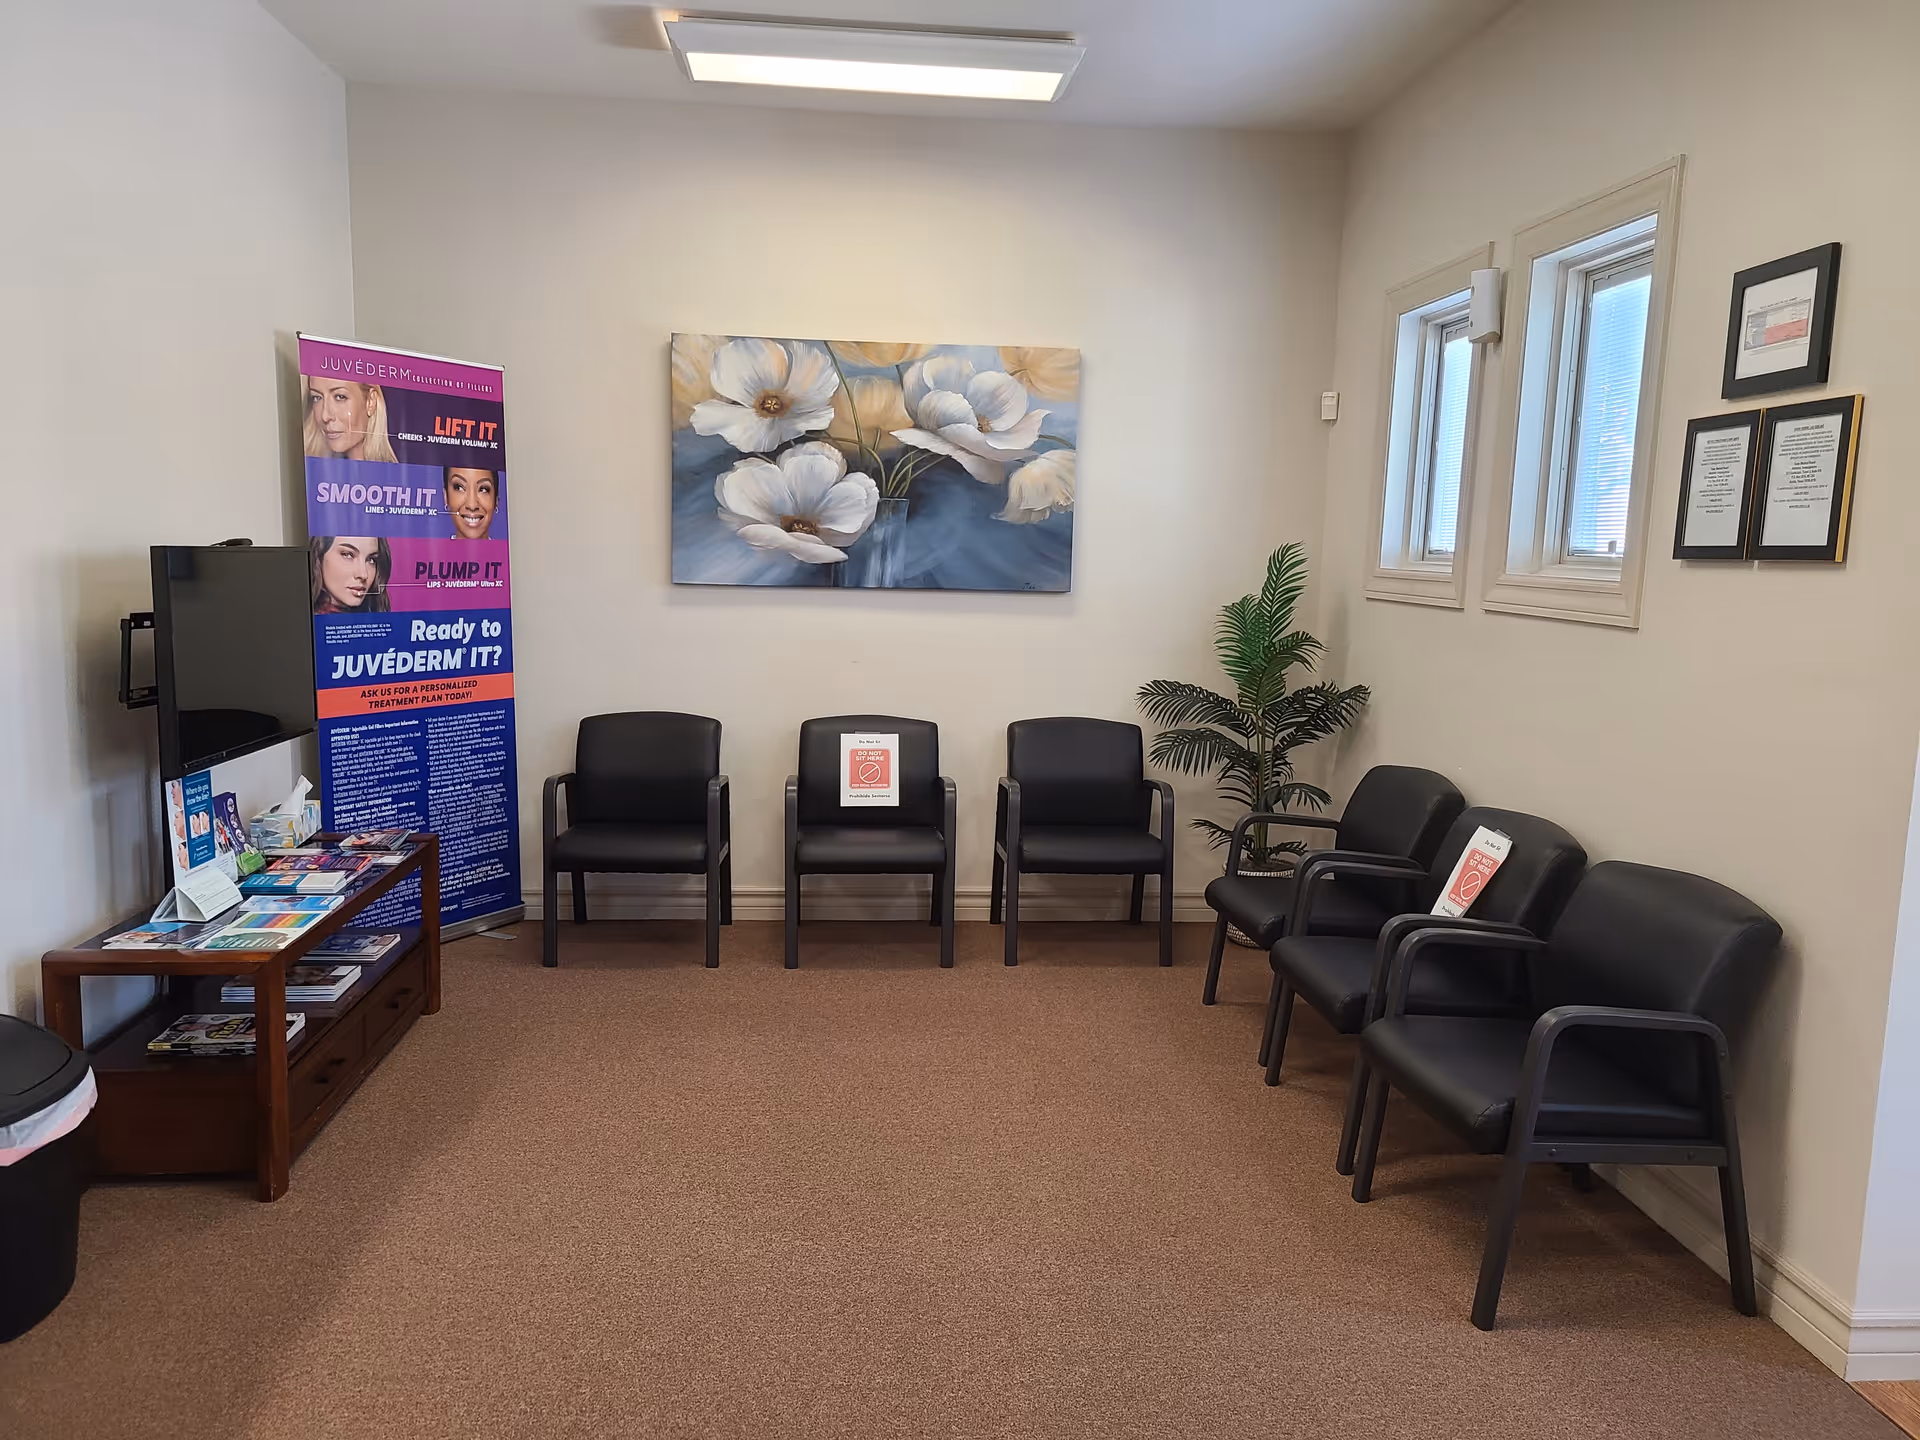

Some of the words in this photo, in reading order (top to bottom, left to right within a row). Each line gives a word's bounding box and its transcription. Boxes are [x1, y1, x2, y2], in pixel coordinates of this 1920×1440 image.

[412, 375, 453, 387] COLLECTION
[456, 381, 464, 389] OF
[467, 382, 493, 393] FILLERS
[434, 416, 476, 438] LIFT
[478, 421, 498, 440] IT
[398, 432, 423, 442] CHEEKS
[427, 435, 460, 446] JUVÉDERM
[316, 482, 411, 506] SMOOTH
[416, 488, 437, 507] IT
[365, 506, 384, 514] LINES
[428, 508, 437, 516] XC
[415, 561, 480, 580] PLUMP
[485, 562, 502, 579] IT
[410, 618, 476, 645] Ready
[481, 618, 502, 637] to
[470, 645, 502, 668] IT?
[360, 689, 379, 699] ASK
[380, 688, 392, 697] US
[393, 686, 410, 696] FOR
[412, 685, 418, 694] A
[420, 680, 478, 693] PERSONALIZED
[368, 696, 420, 709] TREATMENT
[421, 693, 443, 704] PLAN
[445, 690, 473, 701] TODAY!
[1468, 859, 1478, 868] SIT
[1473, 853, 1483, 861] DO
[1481, 857, 1494, 868] NOT
